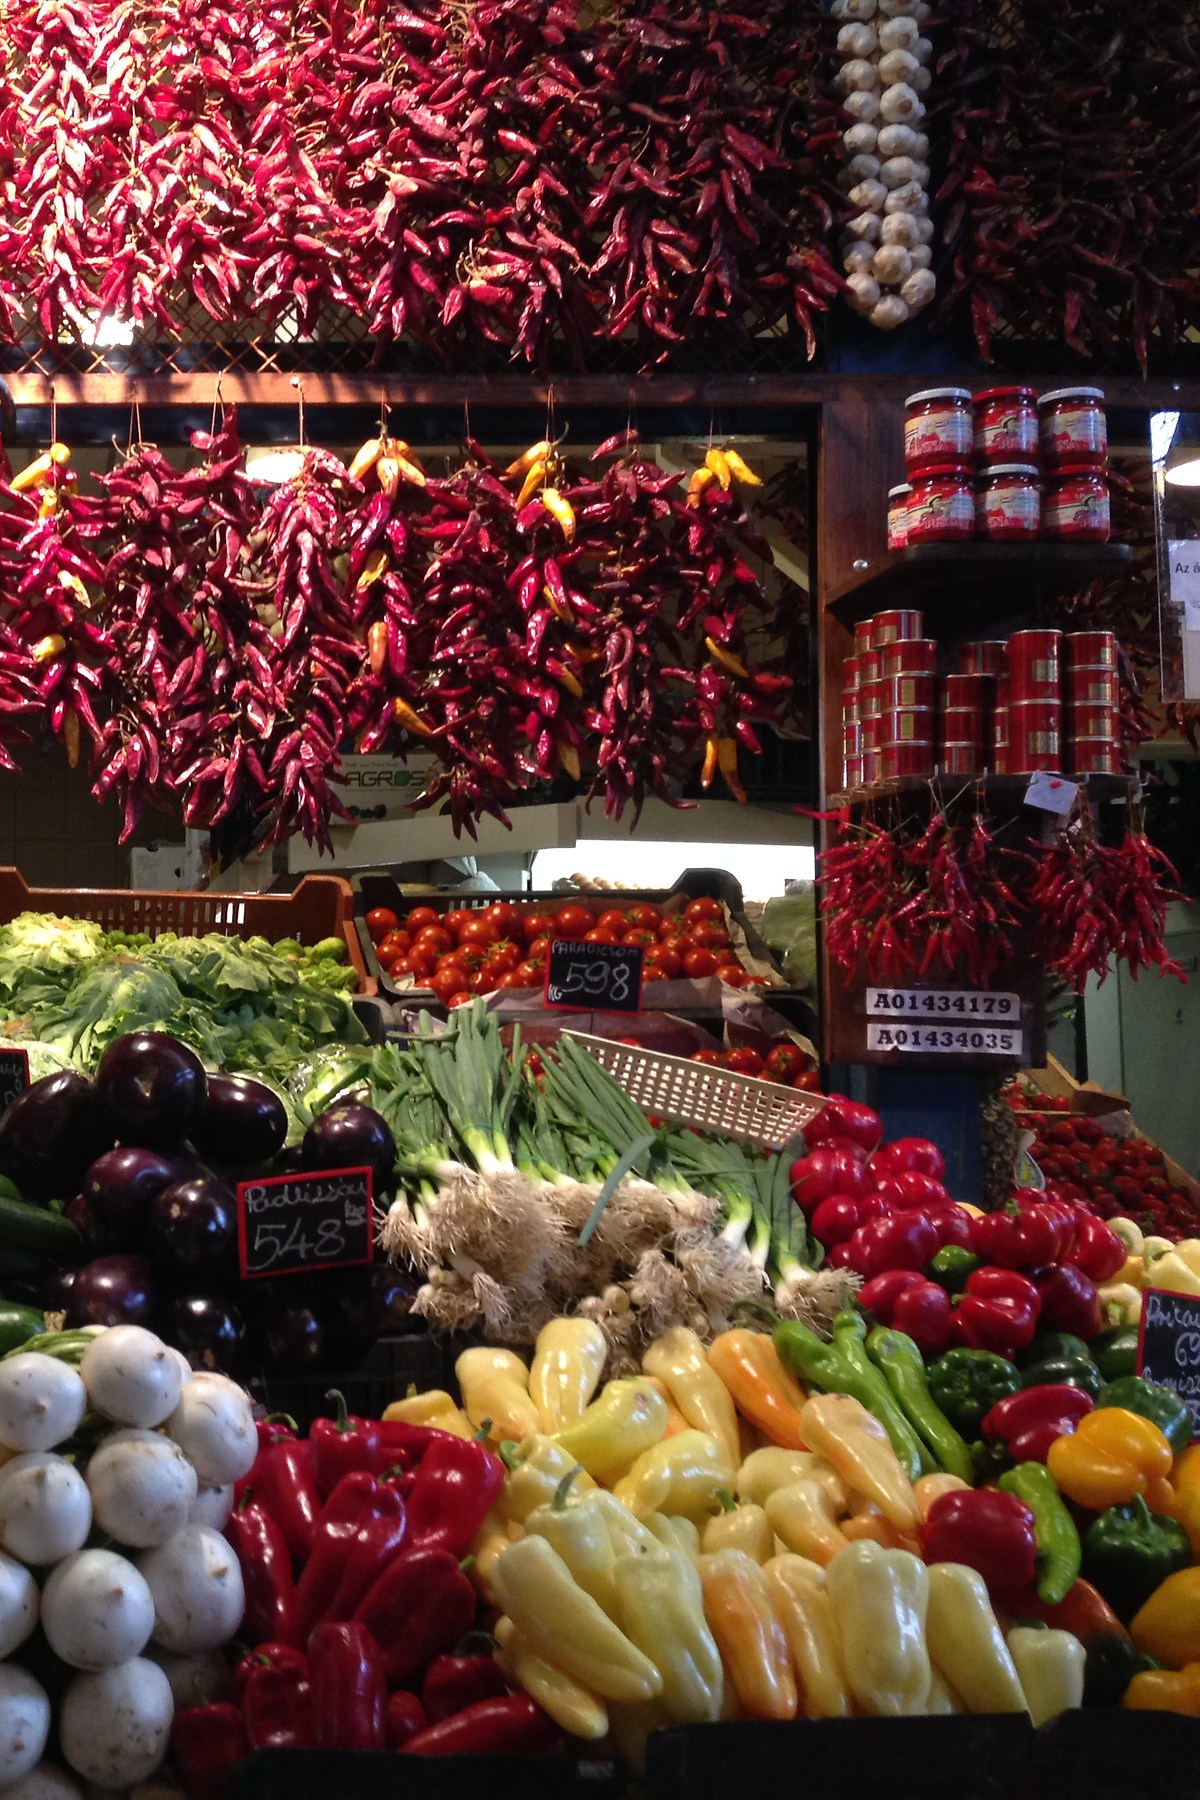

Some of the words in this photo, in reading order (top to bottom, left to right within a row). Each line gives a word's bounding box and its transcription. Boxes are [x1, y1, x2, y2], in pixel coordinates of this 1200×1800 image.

[1175, 562, 1190, 574] Az
[344, 771, 425, 787] AGROS
[552, 939, 639, 957] PARADICSOM
[561, 960, 630, 1001] 598
[874, 993, 1011, 1014] A01434179
[877, 1029, 1013, 1050] A01434035
[246, 1217, 346, 1271] 548
